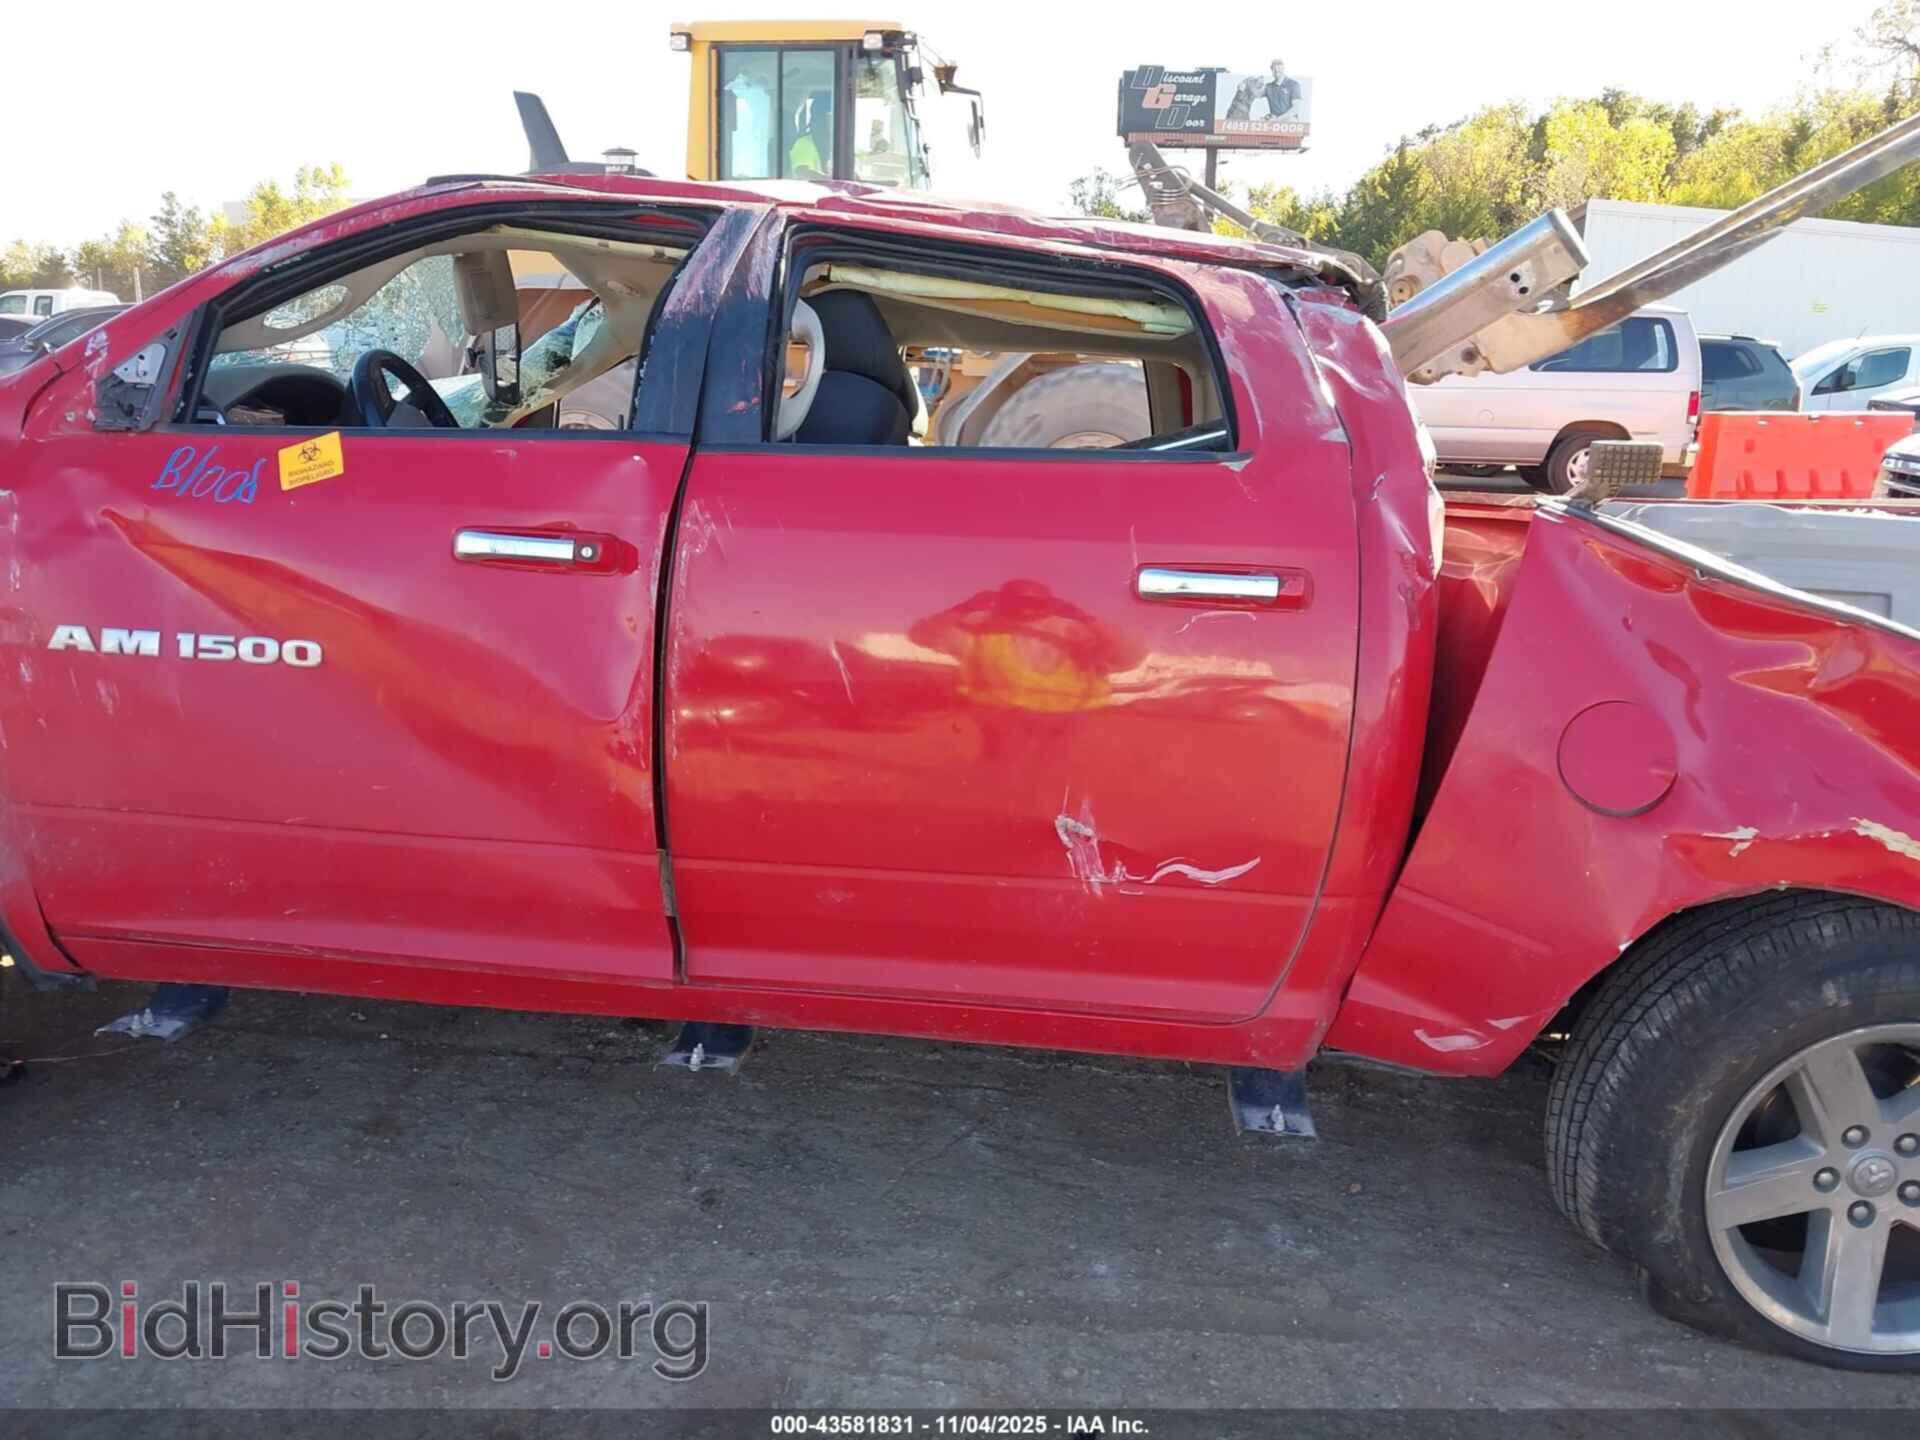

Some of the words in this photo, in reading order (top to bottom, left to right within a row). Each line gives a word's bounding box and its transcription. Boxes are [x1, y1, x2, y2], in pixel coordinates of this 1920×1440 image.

[1131, 65, 1205, 88] Discount
[1142, 84, 1207, 109] Garage
[1155, 104, 1205, 129] Door
[48, 624, 160, 657] AM
[176, 632, 322, 667] 1500
